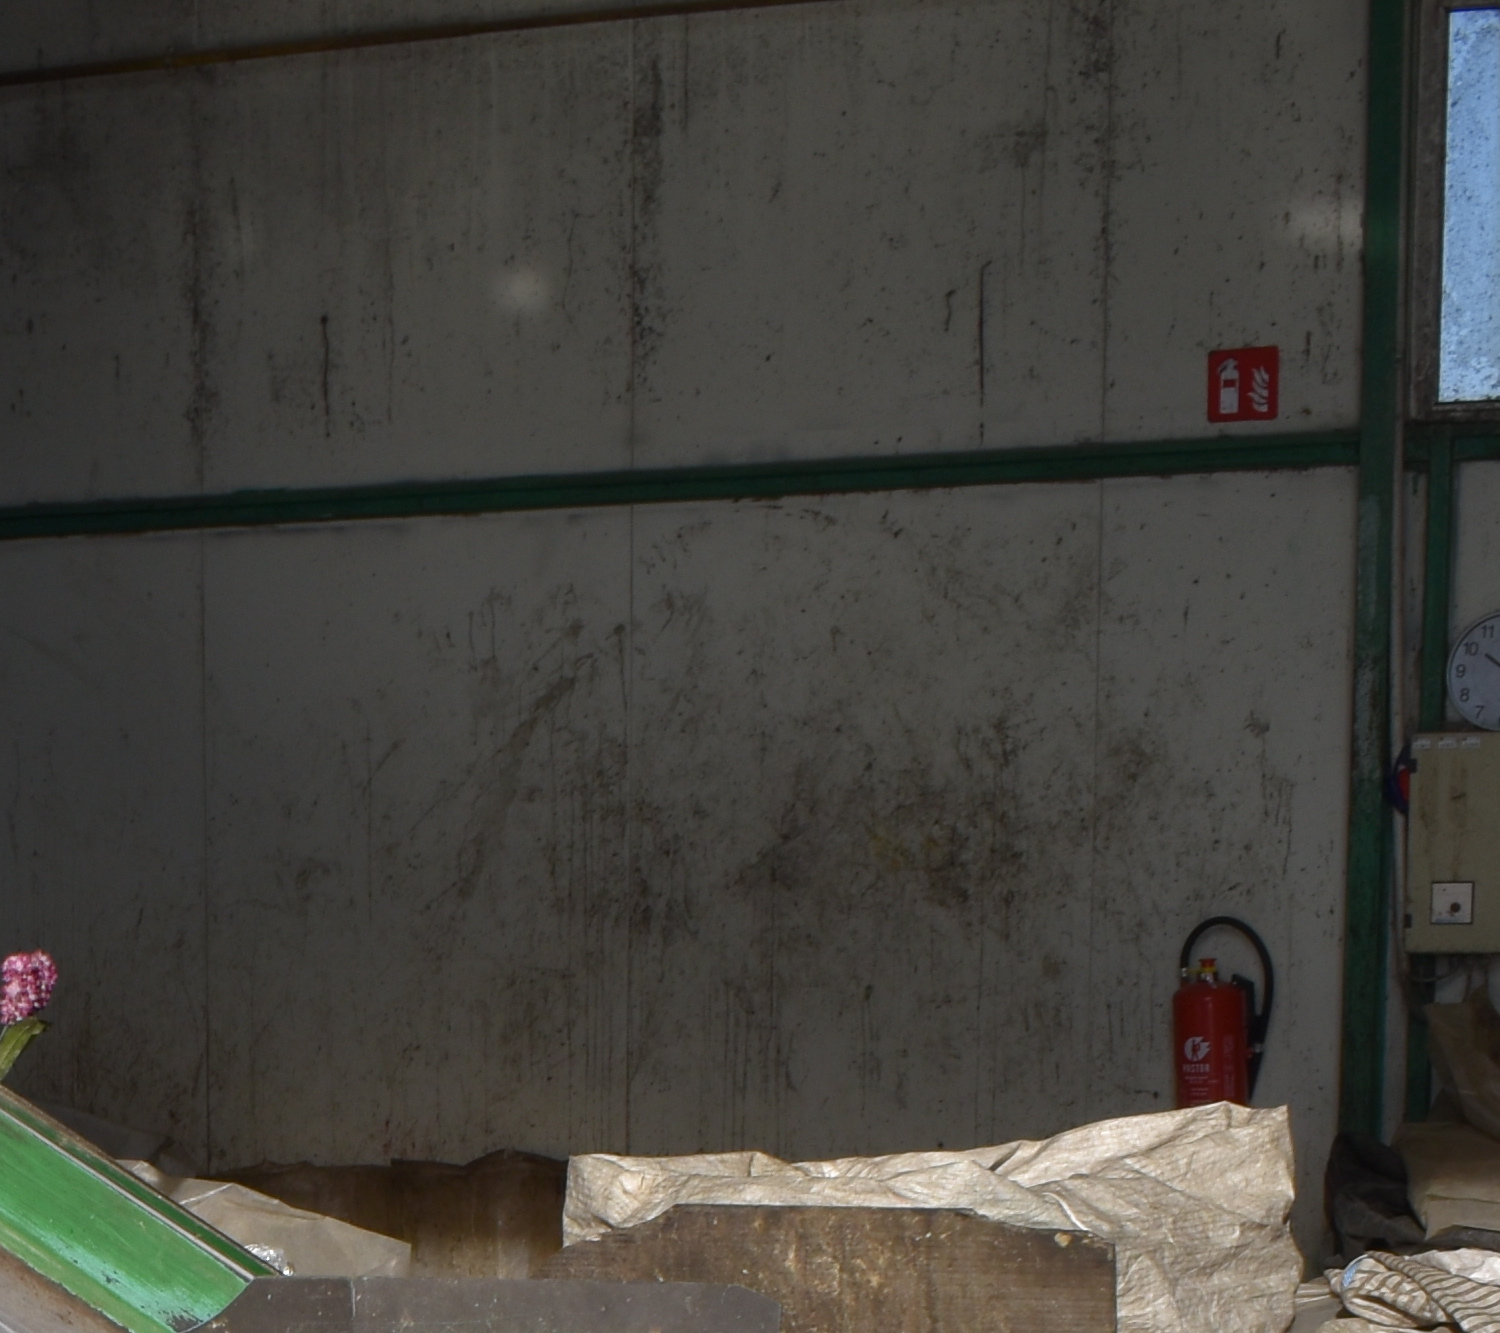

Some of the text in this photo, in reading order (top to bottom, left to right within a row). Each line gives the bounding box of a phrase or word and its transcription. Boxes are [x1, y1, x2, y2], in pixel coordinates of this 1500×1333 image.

[1480, 624, 1495, 638] 11
[1462, 641, 1479, 656] 10
[1454, 663, 1466, 678] 9
[1458, 687, 1470, 703] 8
[1474, 704, 1485, 719] 7
